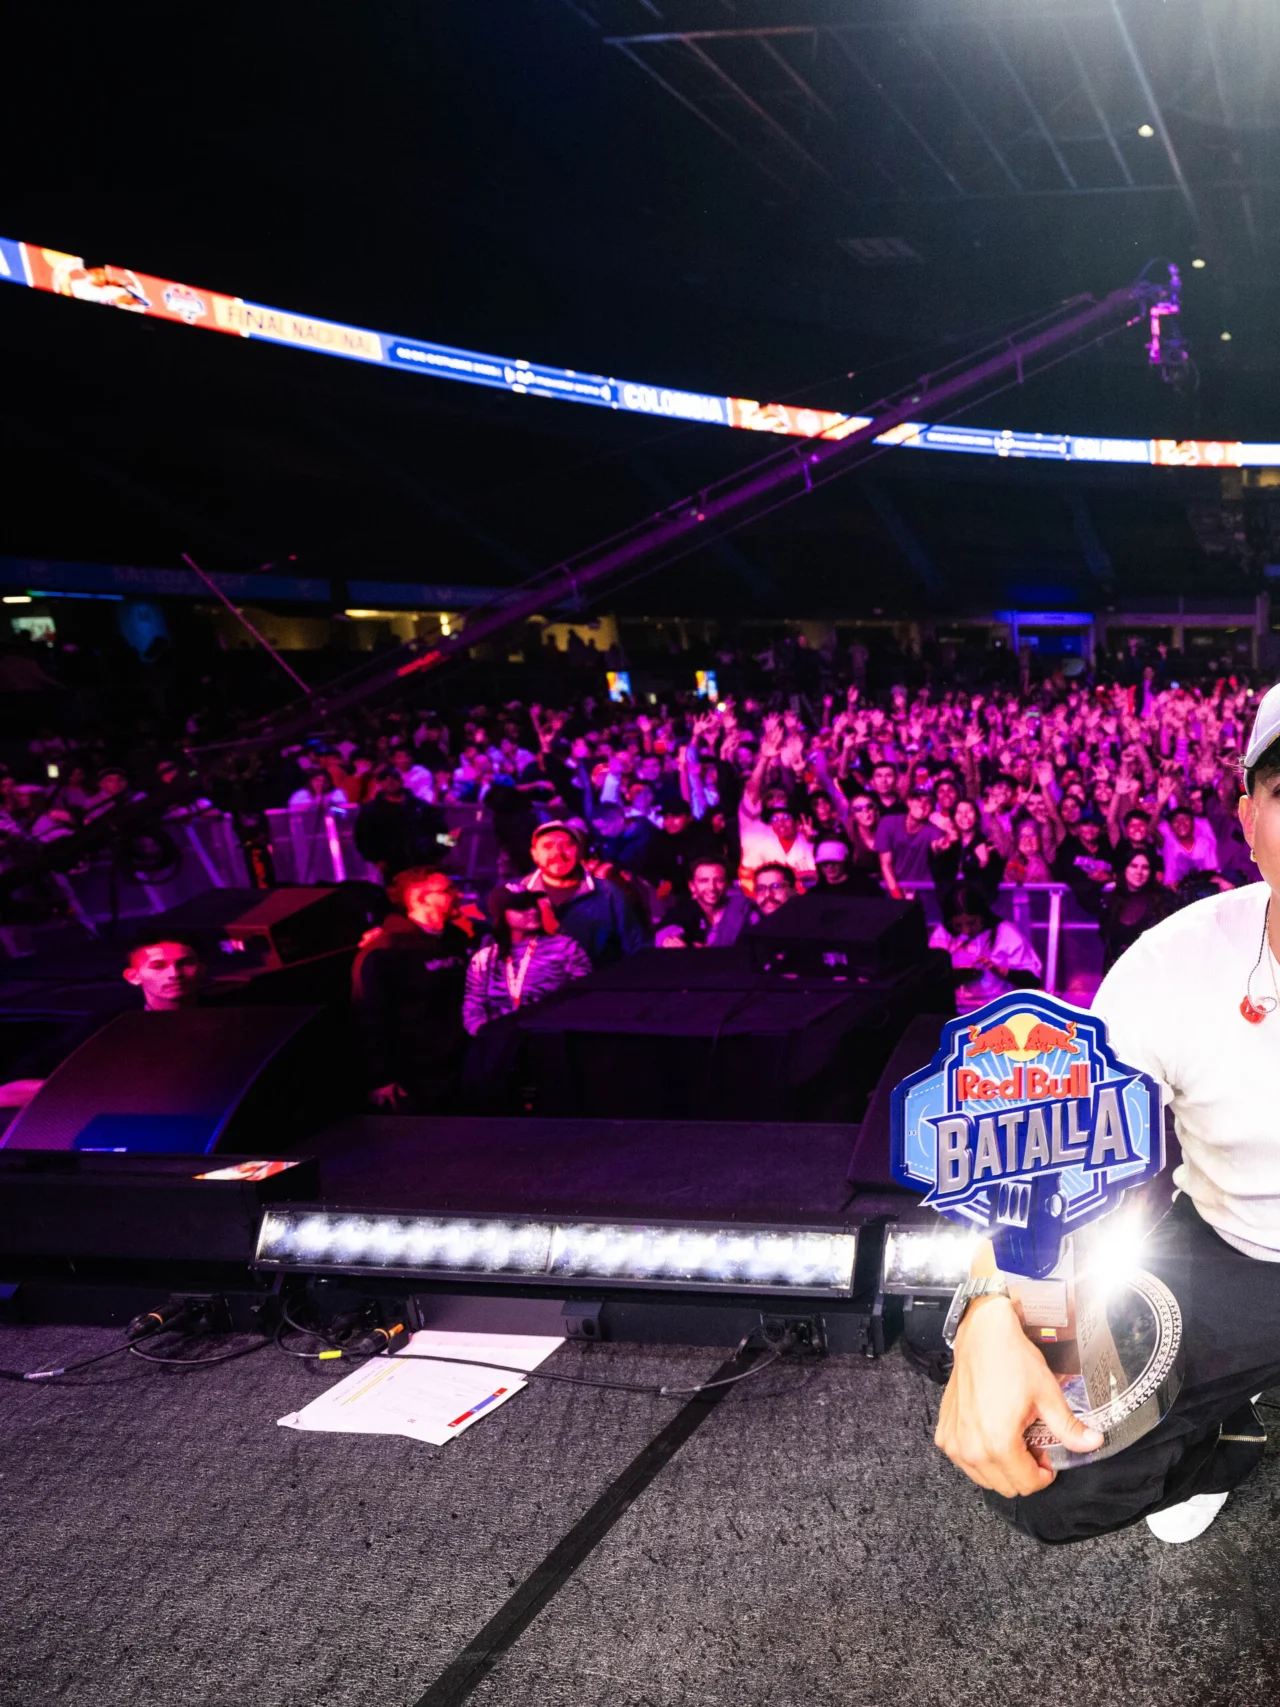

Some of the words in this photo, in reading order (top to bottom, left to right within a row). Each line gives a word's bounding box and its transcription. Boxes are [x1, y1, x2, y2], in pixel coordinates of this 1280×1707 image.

[292, 320, 373, 353] NACINAL
[957, 1066, 1023, 1101] Red
[1026, 1062, 1091, 1100] Bull
[937, 1087, 1128, 1195] BATALLA
